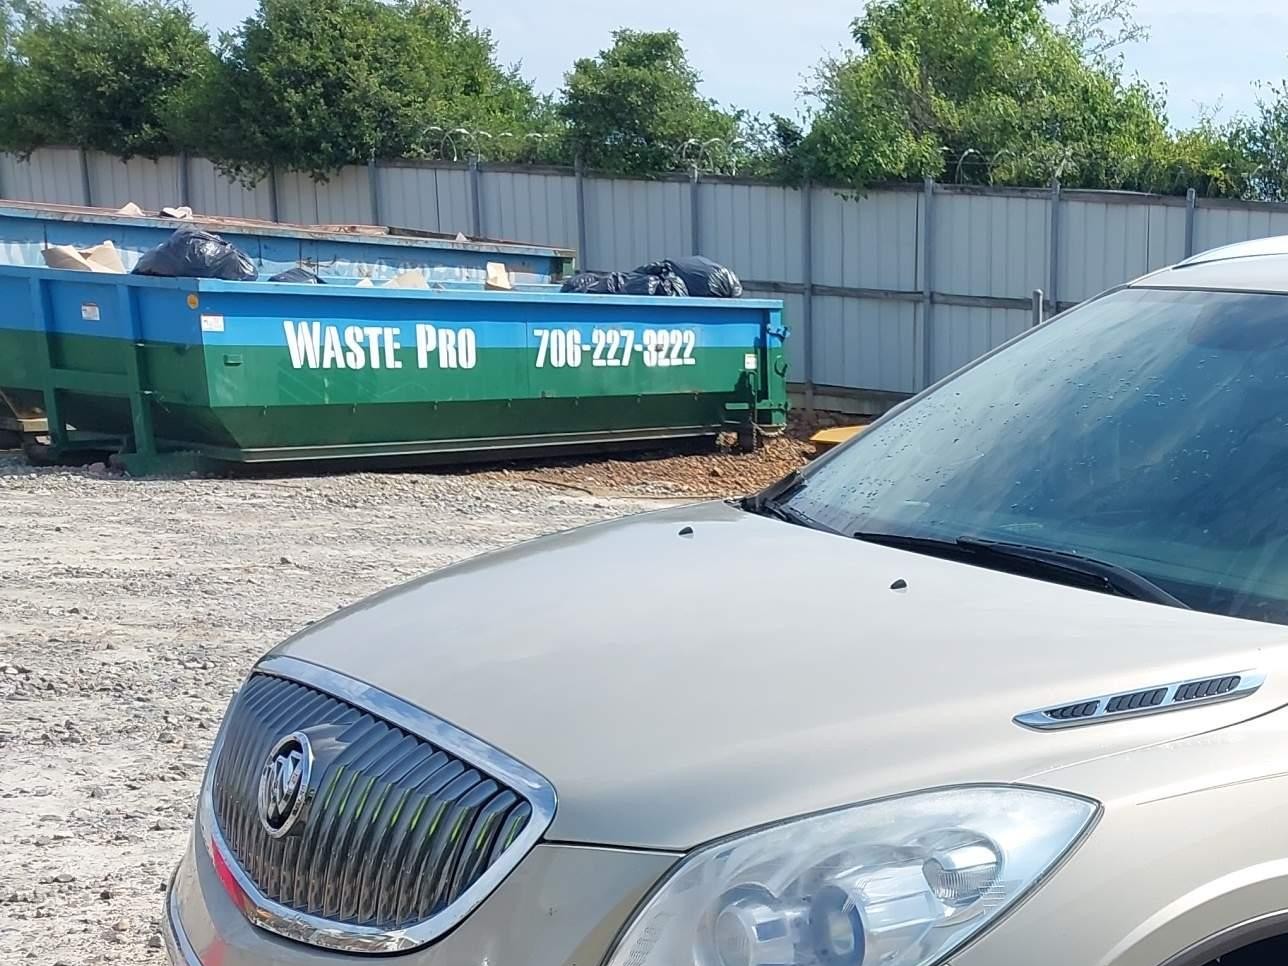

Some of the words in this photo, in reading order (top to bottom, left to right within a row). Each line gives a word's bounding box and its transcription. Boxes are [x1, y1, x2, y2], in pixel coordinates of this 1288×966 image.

[283, 320, 403, 370] WASTE
[415, 323, 476, 370] PRO
[533, 328, 696, 368] 706-227-3222
